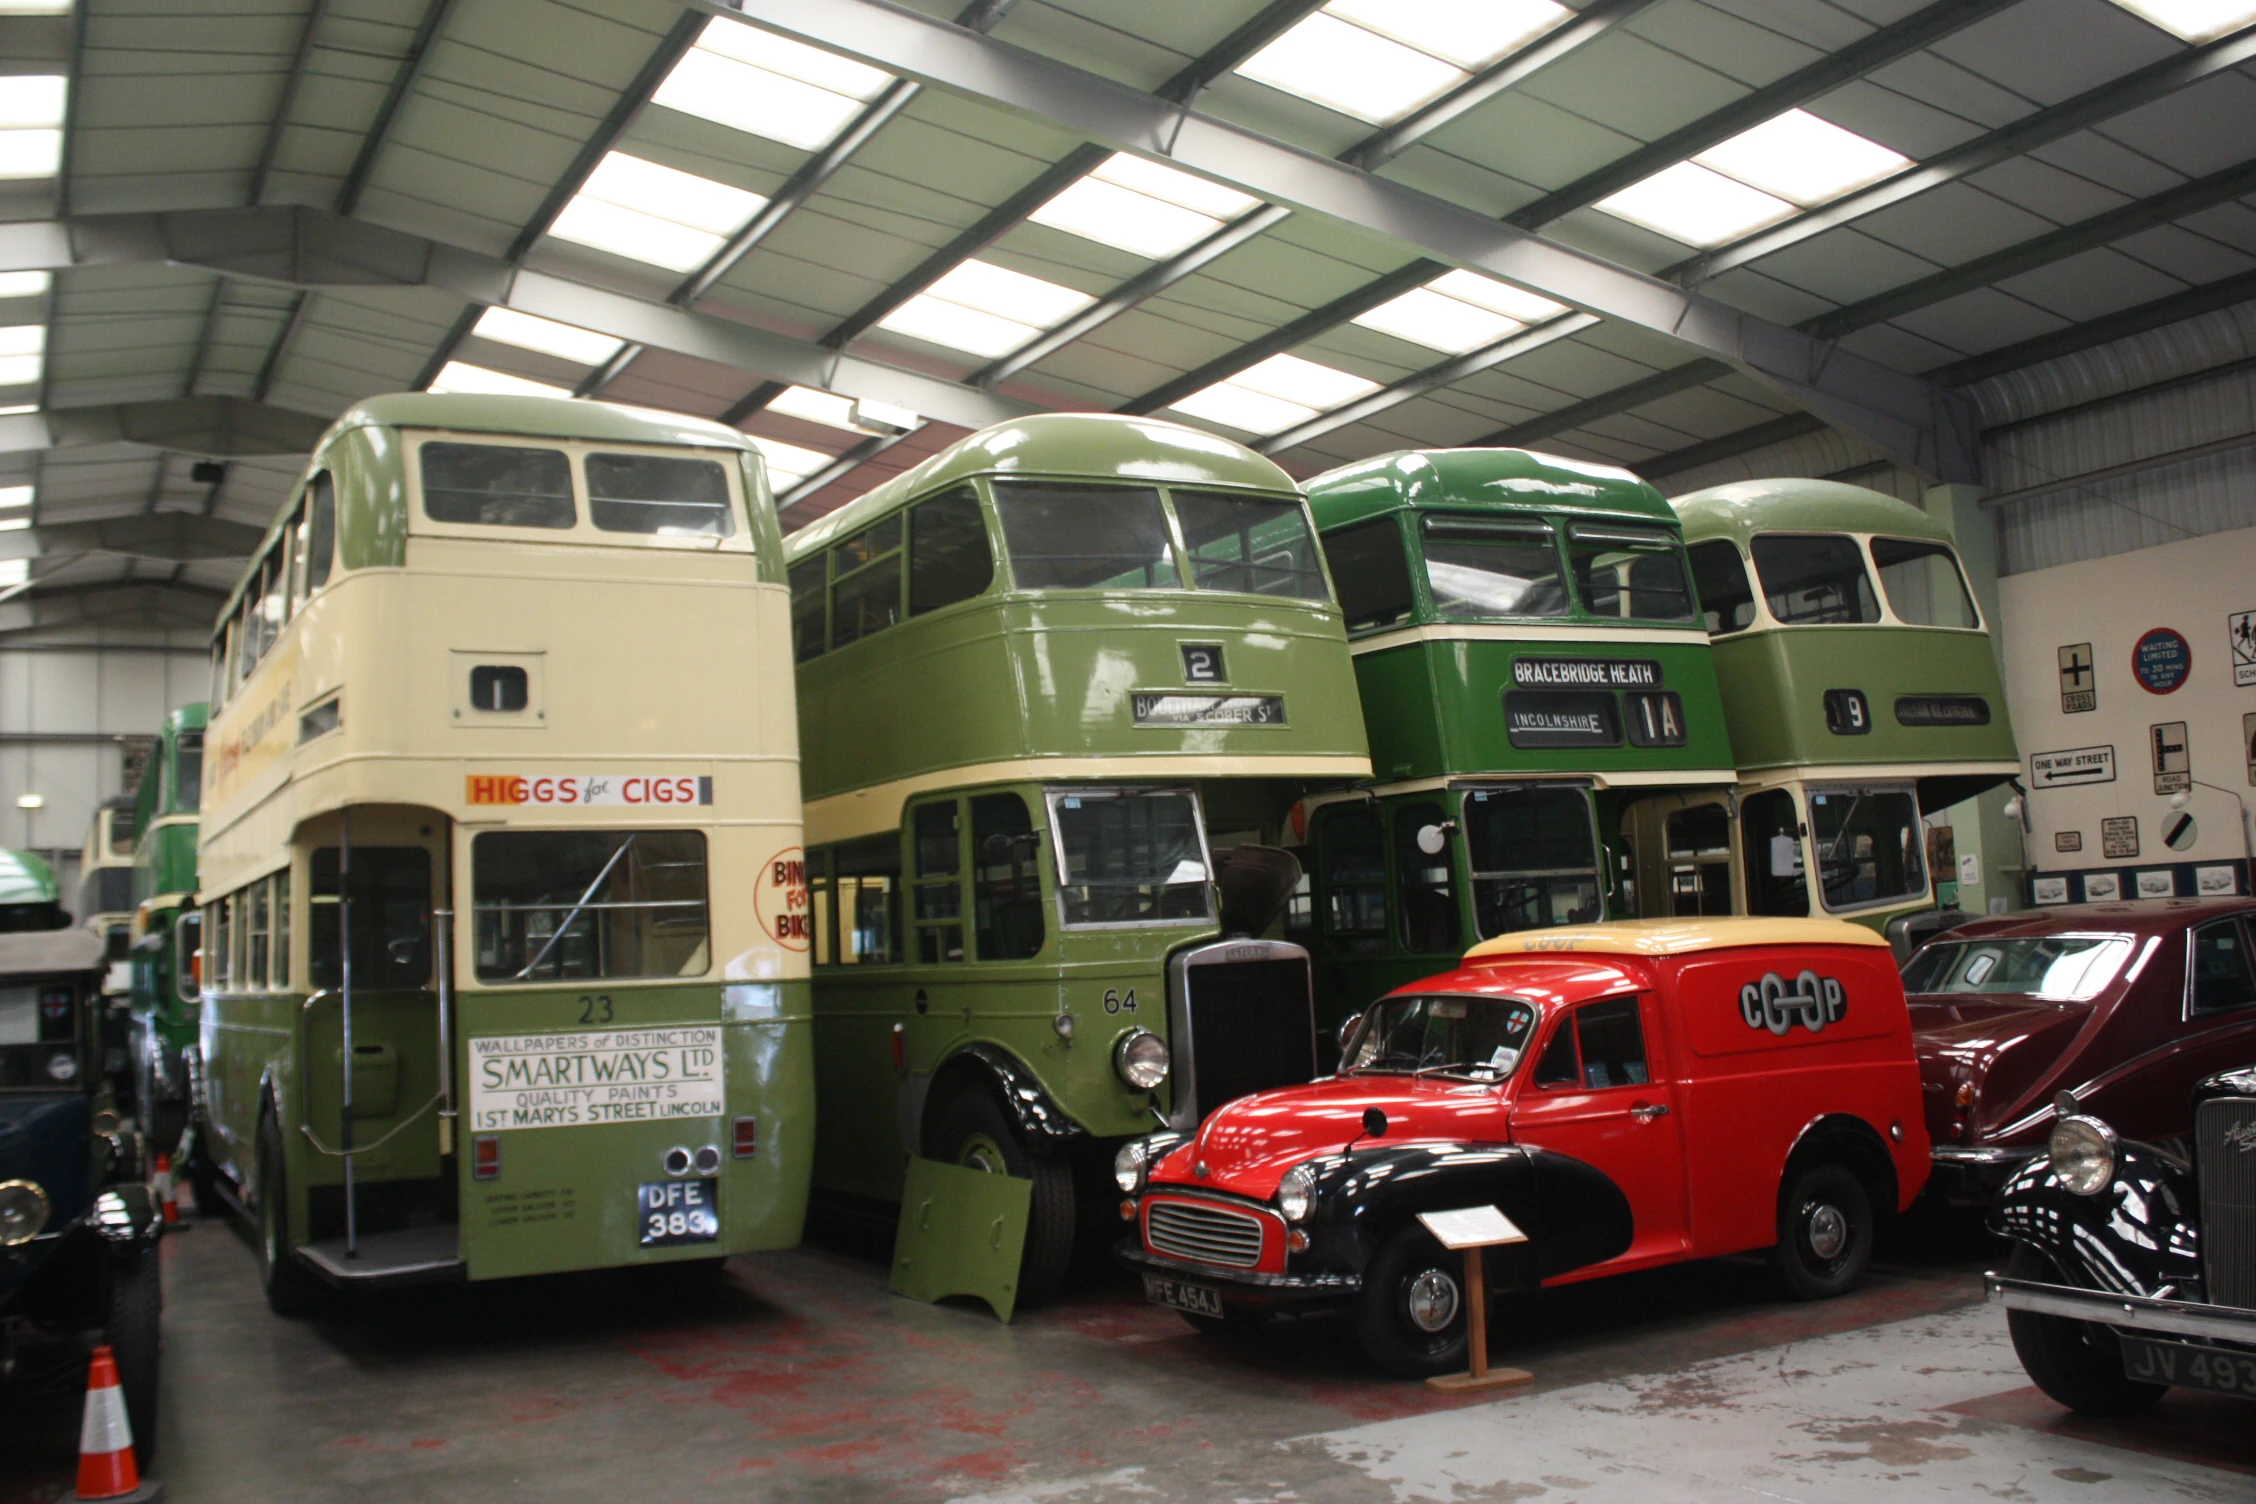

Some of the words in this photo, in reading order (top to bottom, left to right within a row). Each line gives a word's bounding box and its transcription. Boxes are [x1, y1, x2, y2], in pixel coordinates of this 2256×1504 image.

[2141, 640, 2178, 652] WAITING
[2143, 650, 2178, 662] LIMITED
[1190, 651, 1214, 678] 2
[1514, 662, 1608, 683] BRACEBRIDGE
[1610, 664, 1654, 684] HEATH
[2152, 664, 2164, 673] 30
[2066, 693, 2091, 703] CROSS
[2066, 701, 2092, 711] ROADS
[1173, 714, 1190, 722] VIA
[1196, 708, 1253, 722] SCORER
[1848, 696, 1863, 727] 9
[2035, 760, 2053, 770] ONE
[2055, 757, 2073, 768] WAY
[2075, 753, 2110, 765] STREET
[473, 777, 578, 804] HIGGS
[583, 777, 611, 804] for
[622, 777, 694, 803] CIGS
[578, 995, 614, 1024] 23
[1103, 988, 1138, 1014] 64
[475, 1036, 588, 1053] WALLPAPERS
[594, 1035, 612, 1048] of
[615, 1030, 716, 1047] DISTINCTION
[482, 1050, 670, 1089] SMARTWAYS
[516, 1089, 594, 1107] QUALITY
[608, 1084, 677, 1100] PAINTS
[513, 1105, 579, 1126] MARYS
[587, 1101, 658, 1122] STREET
[660, 1101, 720, 1117] LINCOLN
[648, 1182, 703, 1208] DFE
[648, 1210, 706, 1237] 383
[2134, 1345, 2176, 1381] JV
